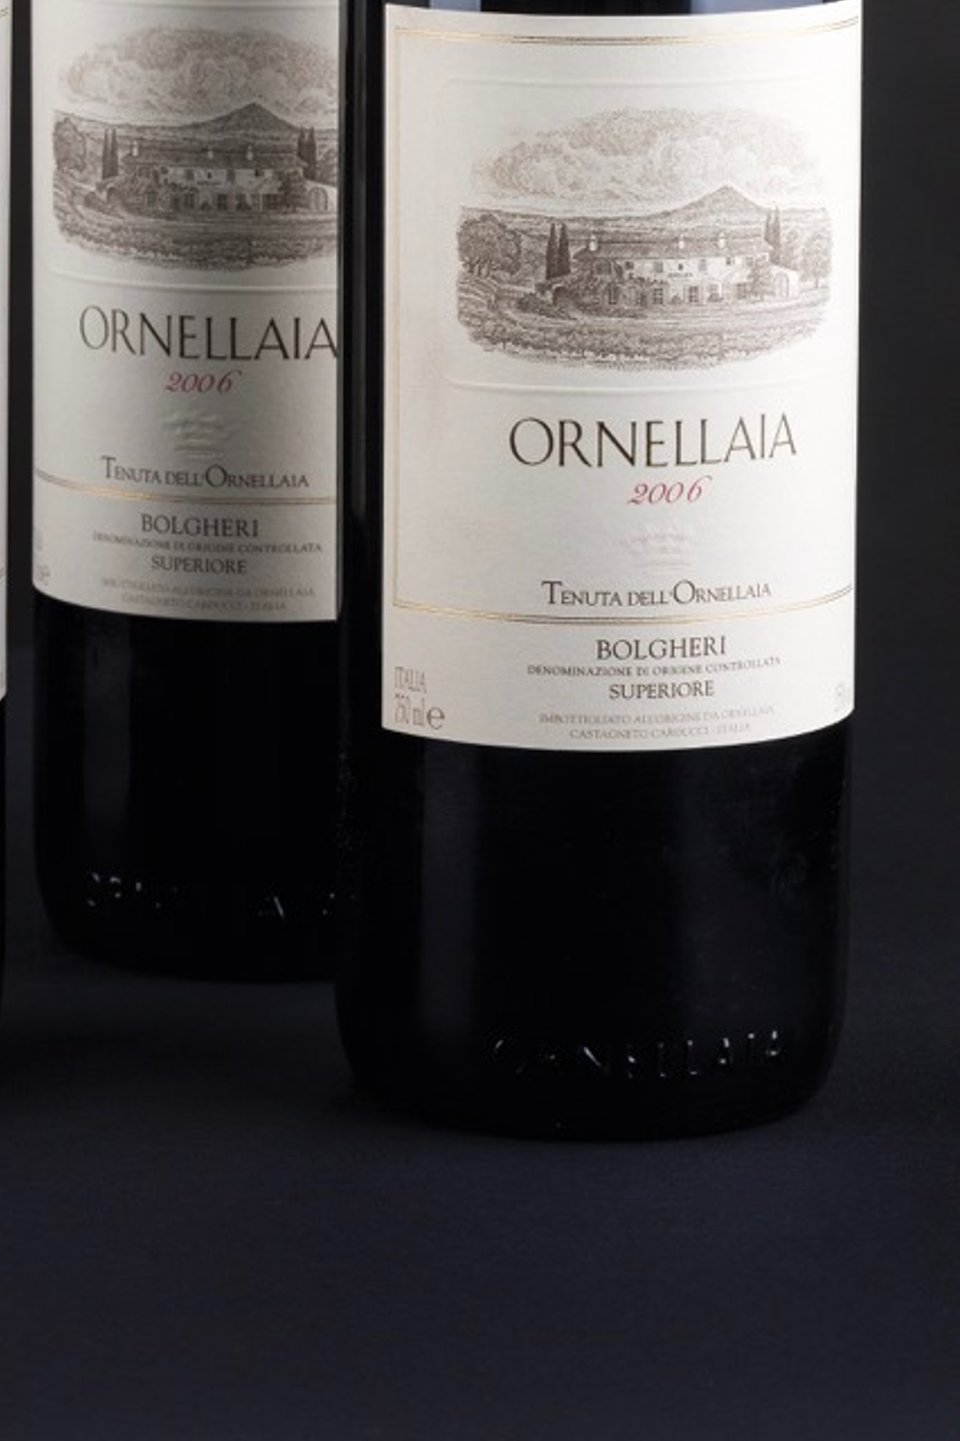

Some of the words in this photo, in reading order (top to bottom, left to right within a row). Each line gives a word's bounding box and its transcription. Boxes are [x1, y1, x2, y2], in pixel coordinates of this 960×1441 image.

[80, 305, 338, 360] ORNELLAIA
[165, 369, 242, 393] 2006
[509, 413, 797, 468] ORNELLAIA
[102, 456, 161, 484] TENUTA
[627, 475, 712, 505] 2006
[141, 513, 259, 538] BOLGHERI
[151, 555, 247, 575] SUPERIORE
[542, 580, 622, 606] TENUTA
[596, 636, 726, 661] BOLGHERI
[527, 665, 631, 677] DENOMINAZIONE
[609, 680, 715, 700] SUPERIORE
